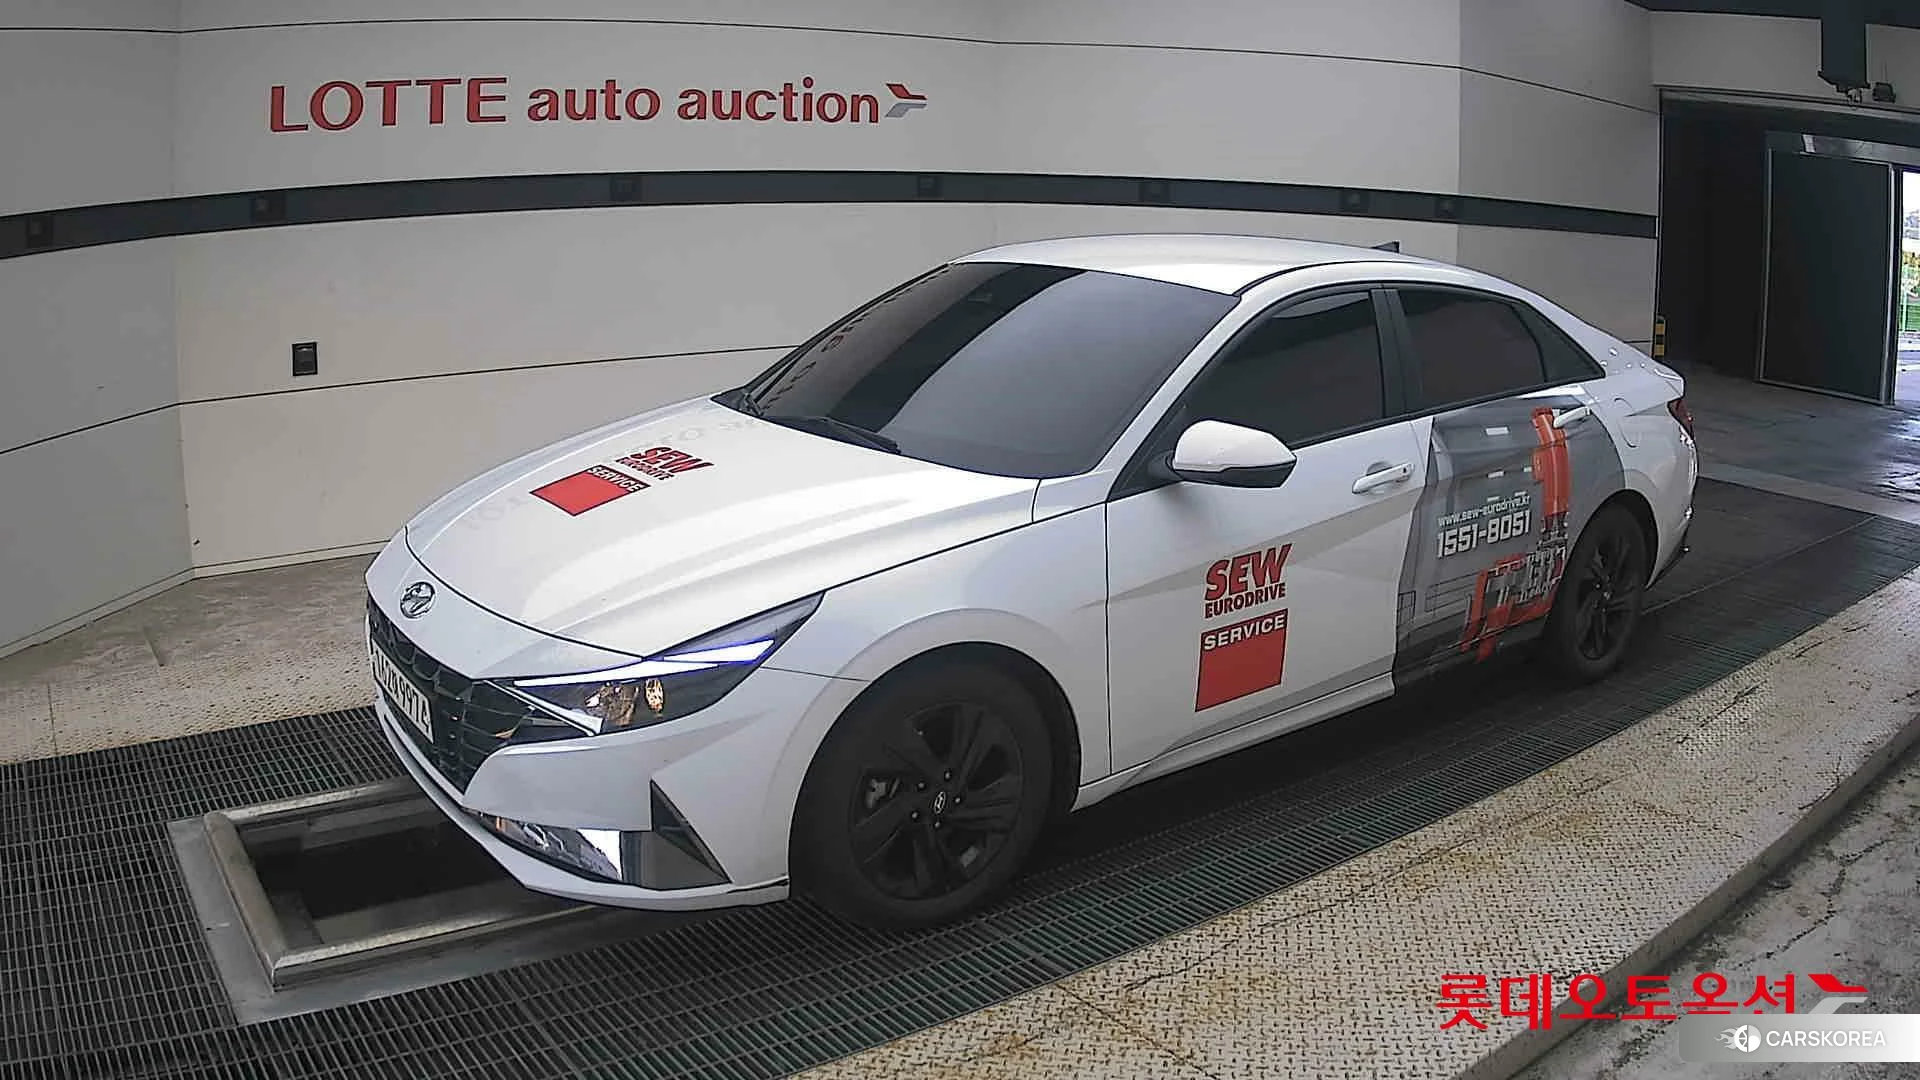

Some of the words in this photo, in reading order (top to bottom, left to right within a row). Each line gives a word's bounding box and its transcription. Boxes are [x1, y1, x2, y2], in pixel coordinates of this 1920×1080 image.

[269, 76, 508, 133] LOTTE
[526, 78, 662, 122] auto
[677, 77, 880, 123] auction
[588, 465, 644, 493] SERVICE
[630, 447, 714, 475] SEW
[1437, 509, 1531, 559] 1551-8051
[1204, 543, 1292, 601] SEW
[1204, 582, 1286, 619] EURODRIVE
[1203, 613, 1286, 652] SERVICE
